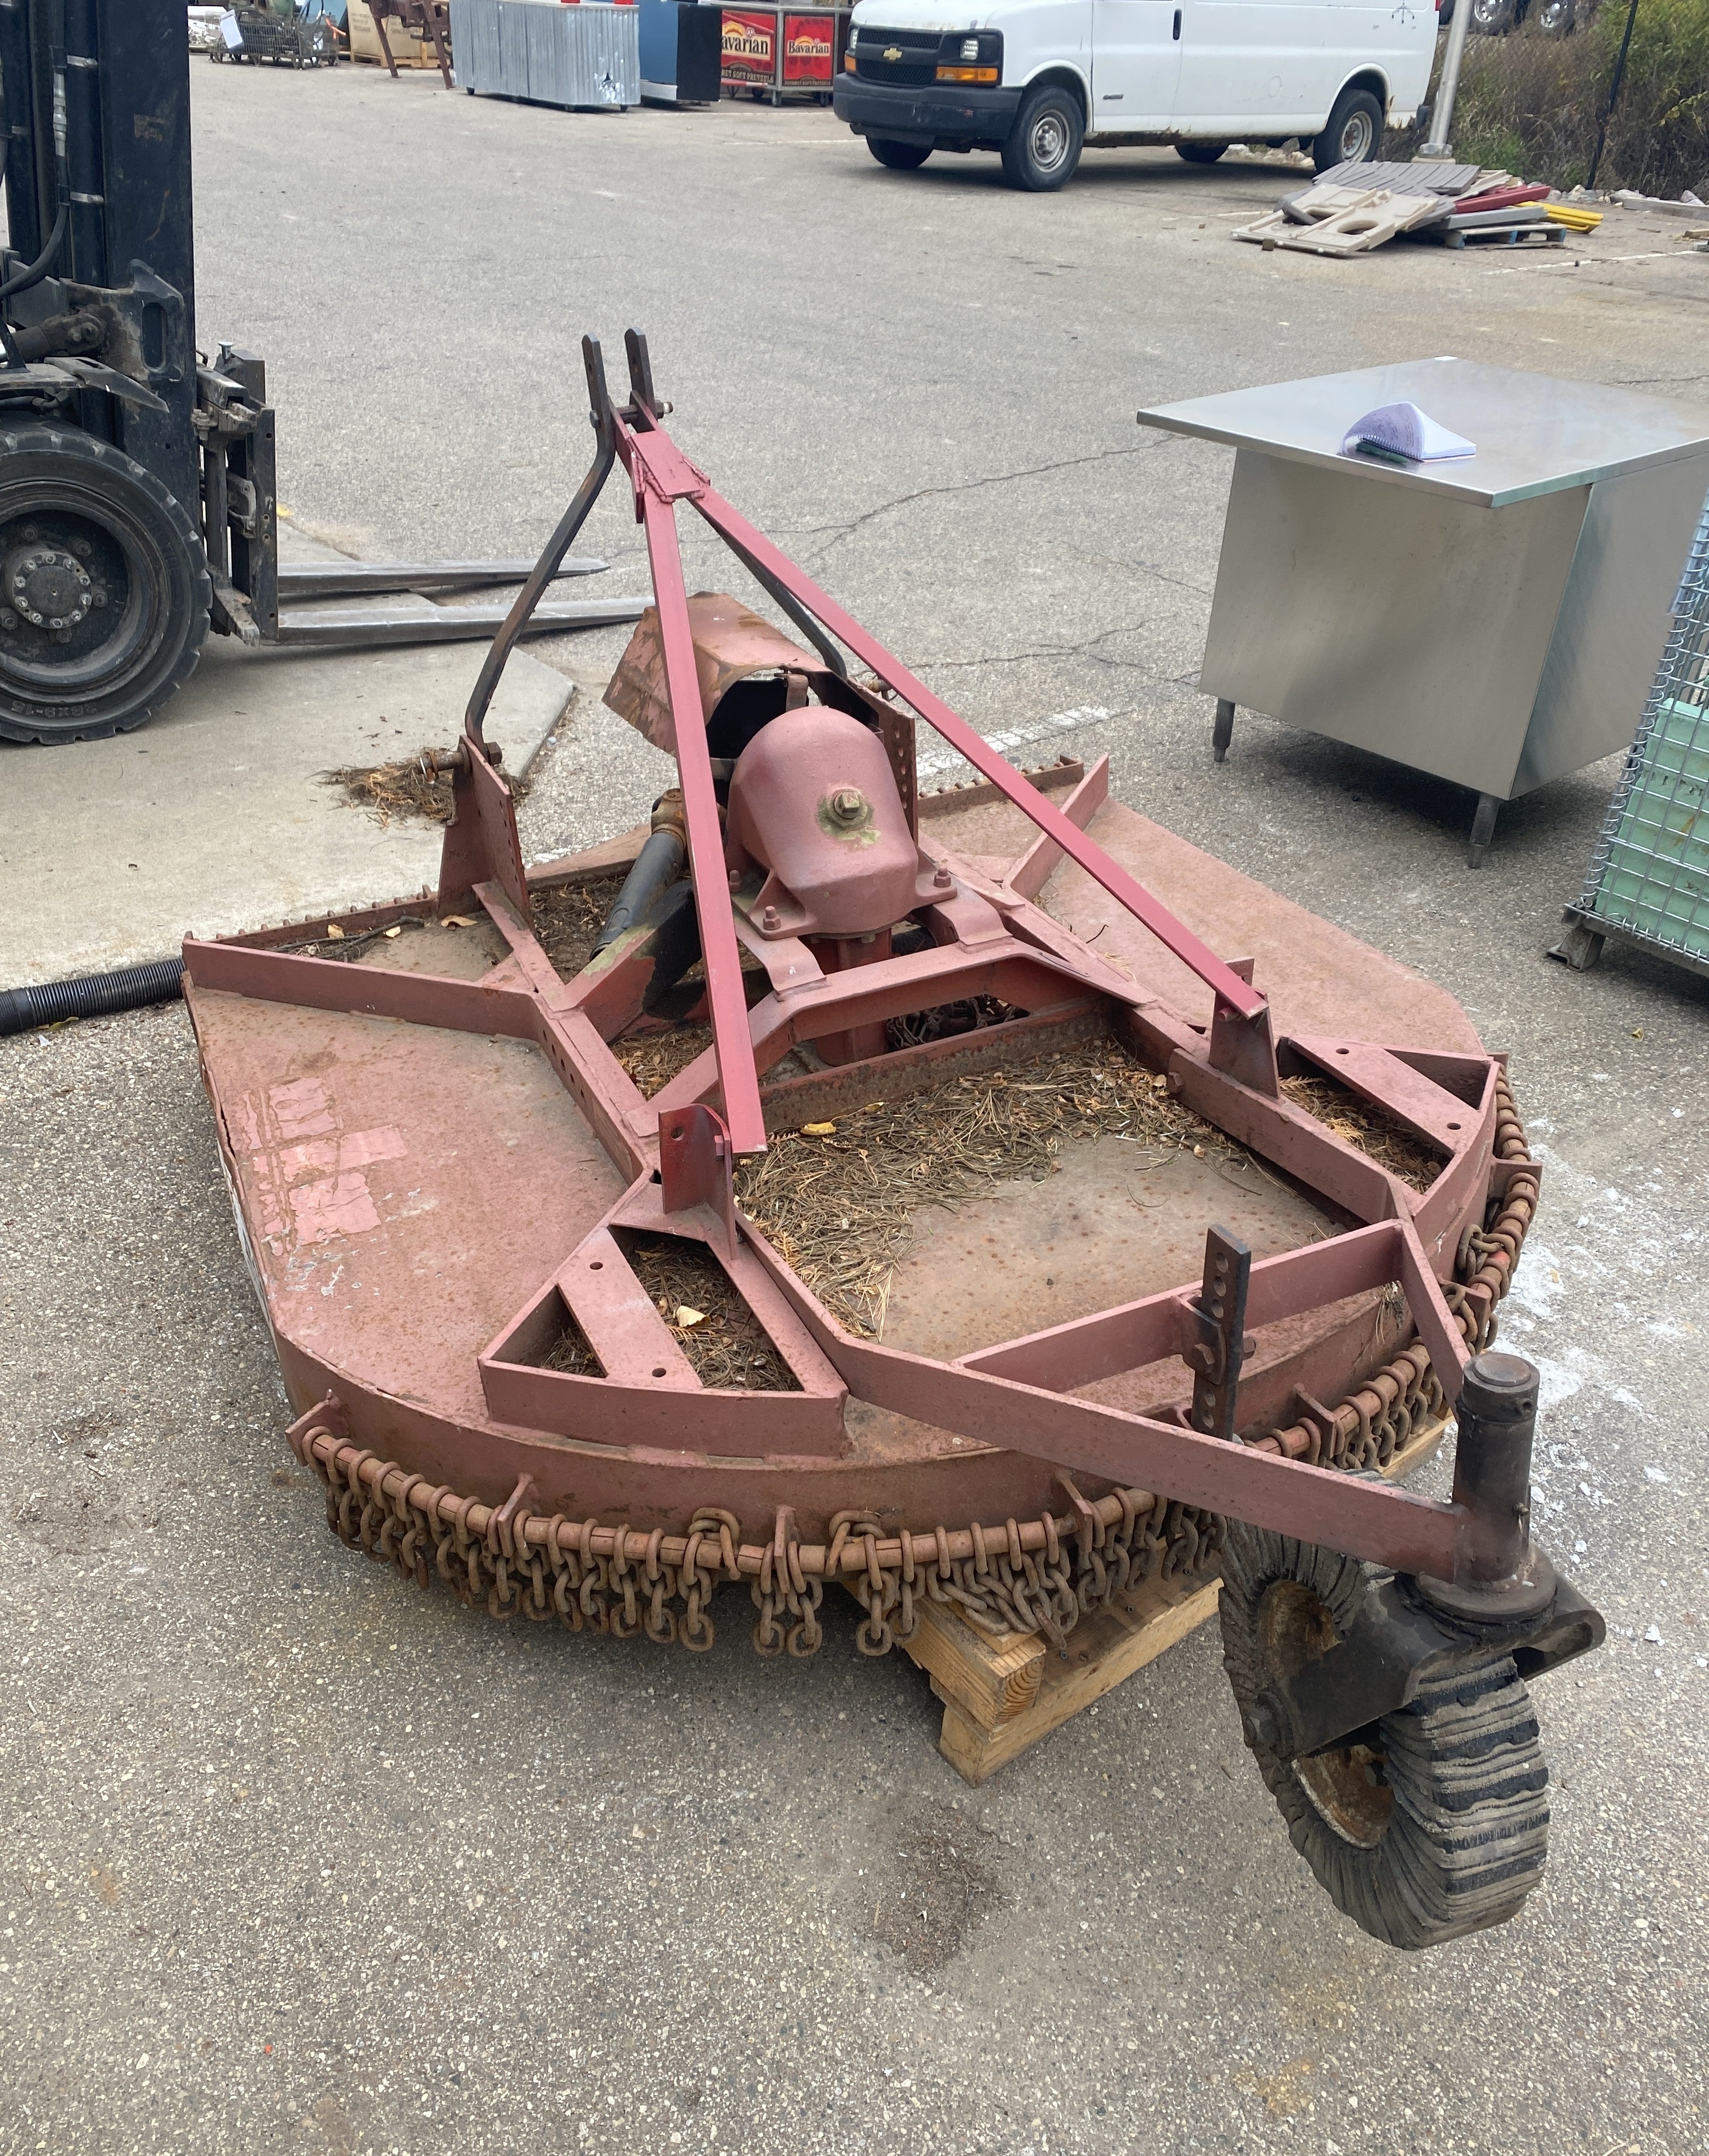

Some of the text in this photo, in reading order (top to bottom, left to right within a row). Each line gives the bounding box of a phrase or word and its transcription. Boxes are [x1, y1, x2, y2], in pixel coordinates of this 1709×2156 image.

[722, 36, 768, 54] avarian
[788, 41, 829, 53] Bavarian
[747, 72, 774, 83] PRETZELS
